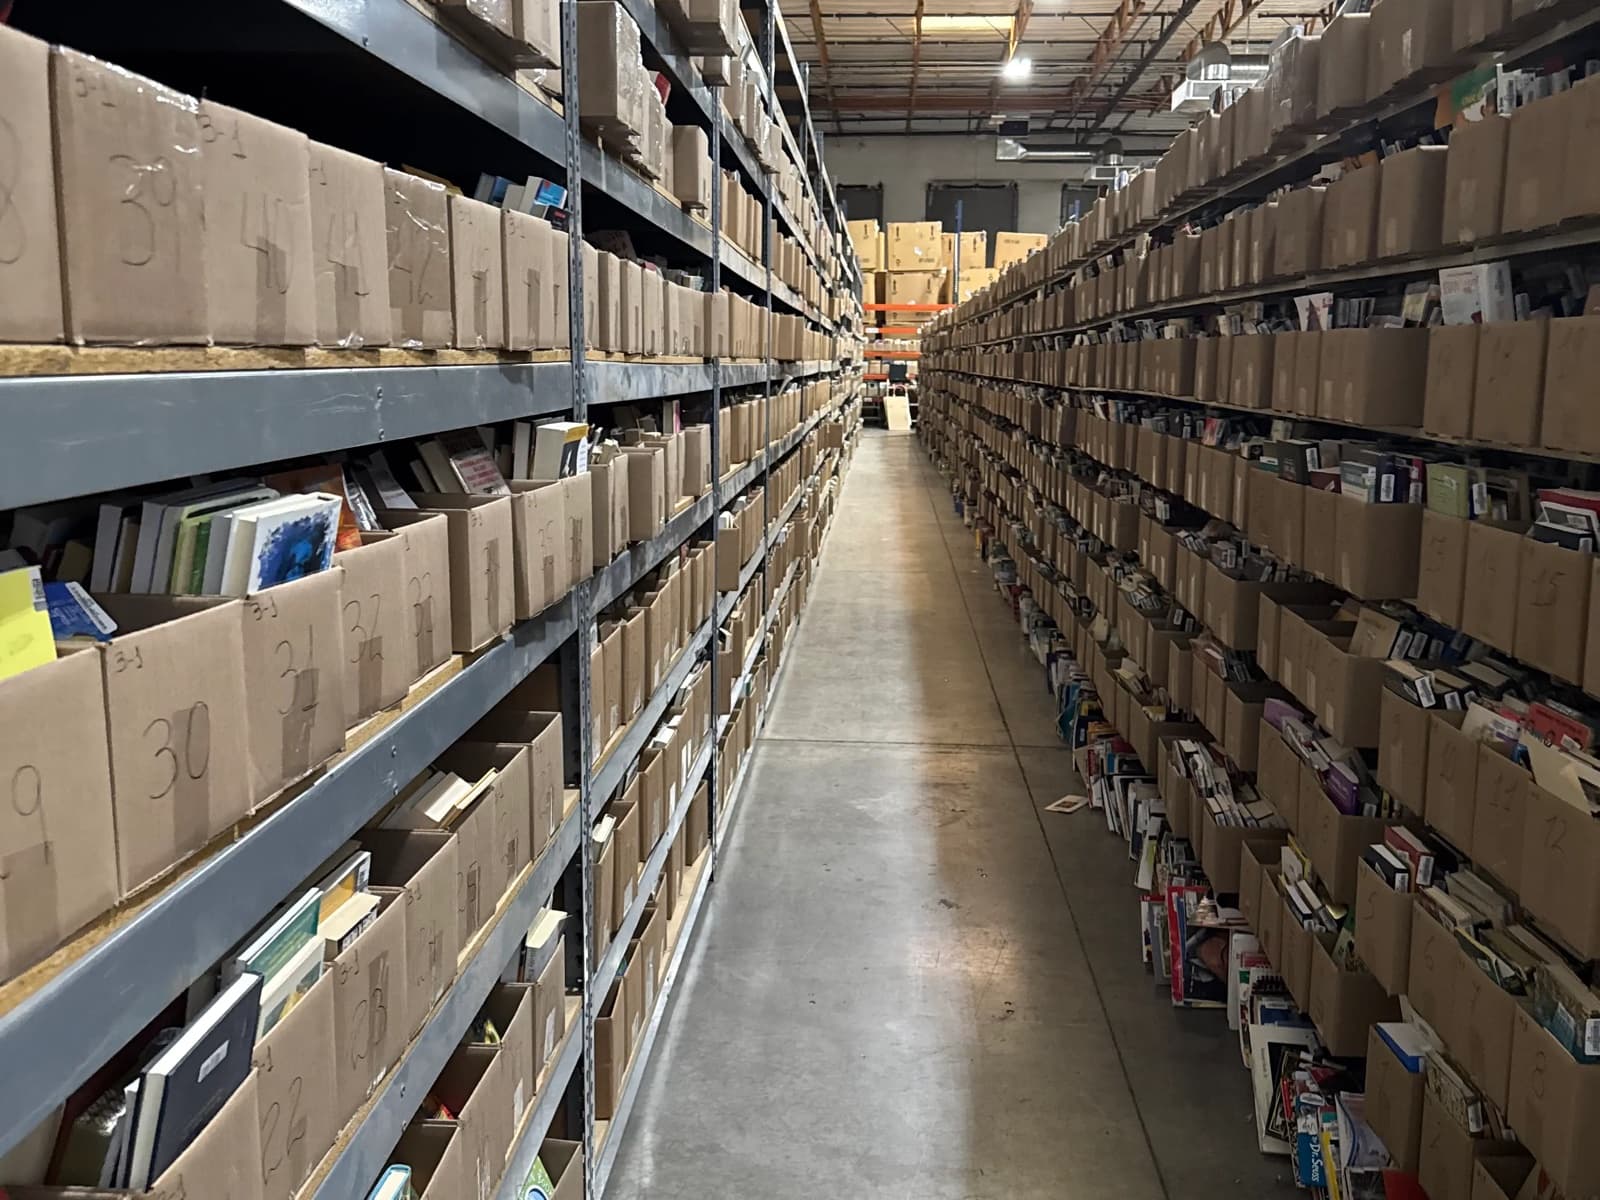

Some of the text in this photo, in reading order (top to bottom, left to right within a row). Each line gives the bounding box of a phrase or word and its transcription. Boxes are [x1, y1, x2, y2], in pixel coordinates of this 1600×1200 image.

[112, 643, 145, 674] 3-1
[342, 591, 386, 665] 32
[273, 622, 321, 716] 31
[142, 699, 212, 801] 30
[351, 986, 389, 1071] 23
[1309, 1143, 1321, 1159] Dr.
[1311, 1159, 1324, 1183] Seuss
